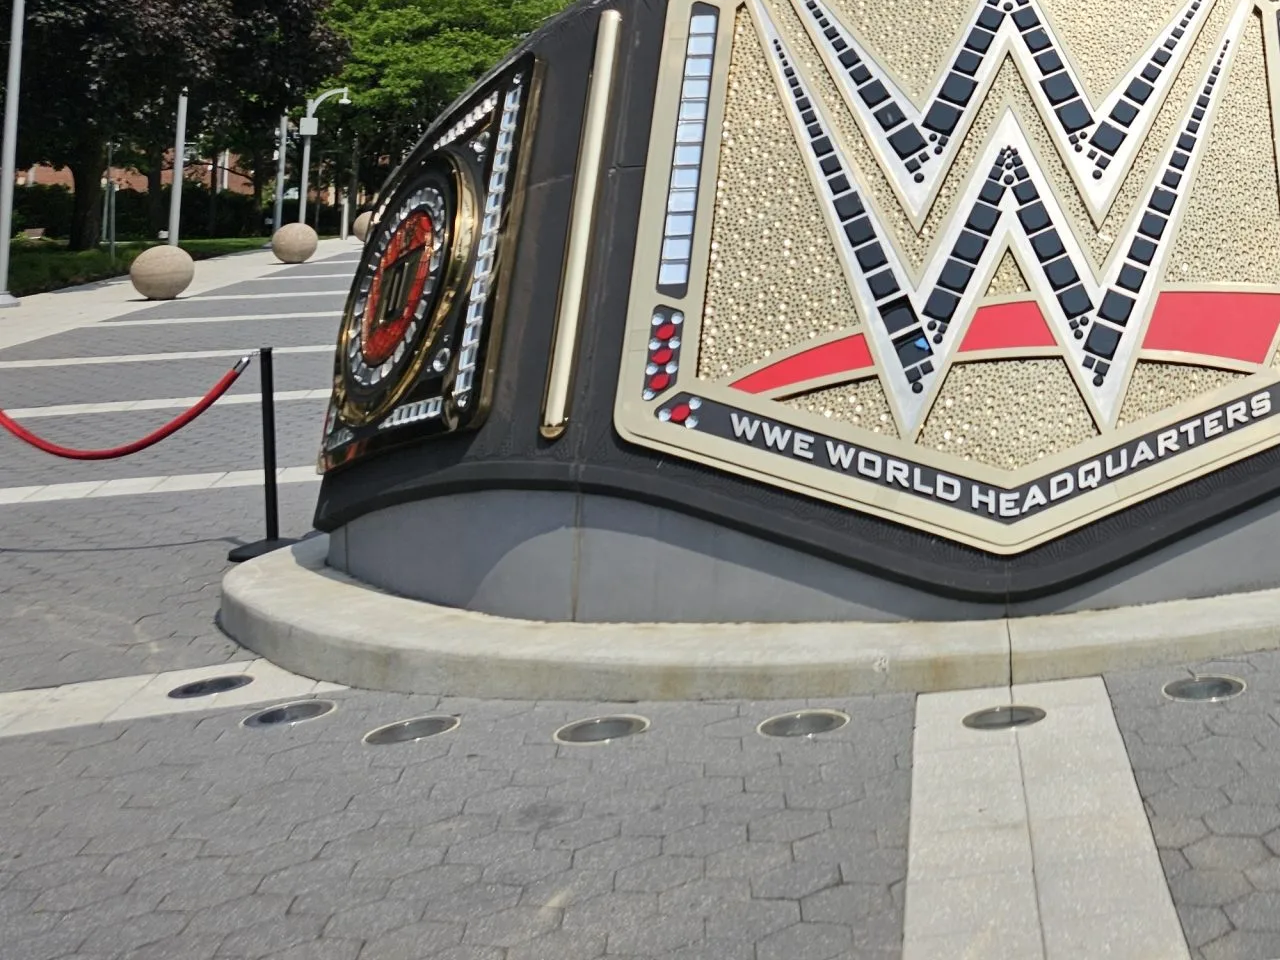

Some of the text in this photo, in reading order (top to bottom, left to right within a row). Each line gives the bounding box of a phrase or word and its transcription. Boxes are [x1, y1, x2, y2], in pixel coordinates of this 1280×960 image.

[730, 391, 1273, 518] WWE WORLD HEADQUARTERS
